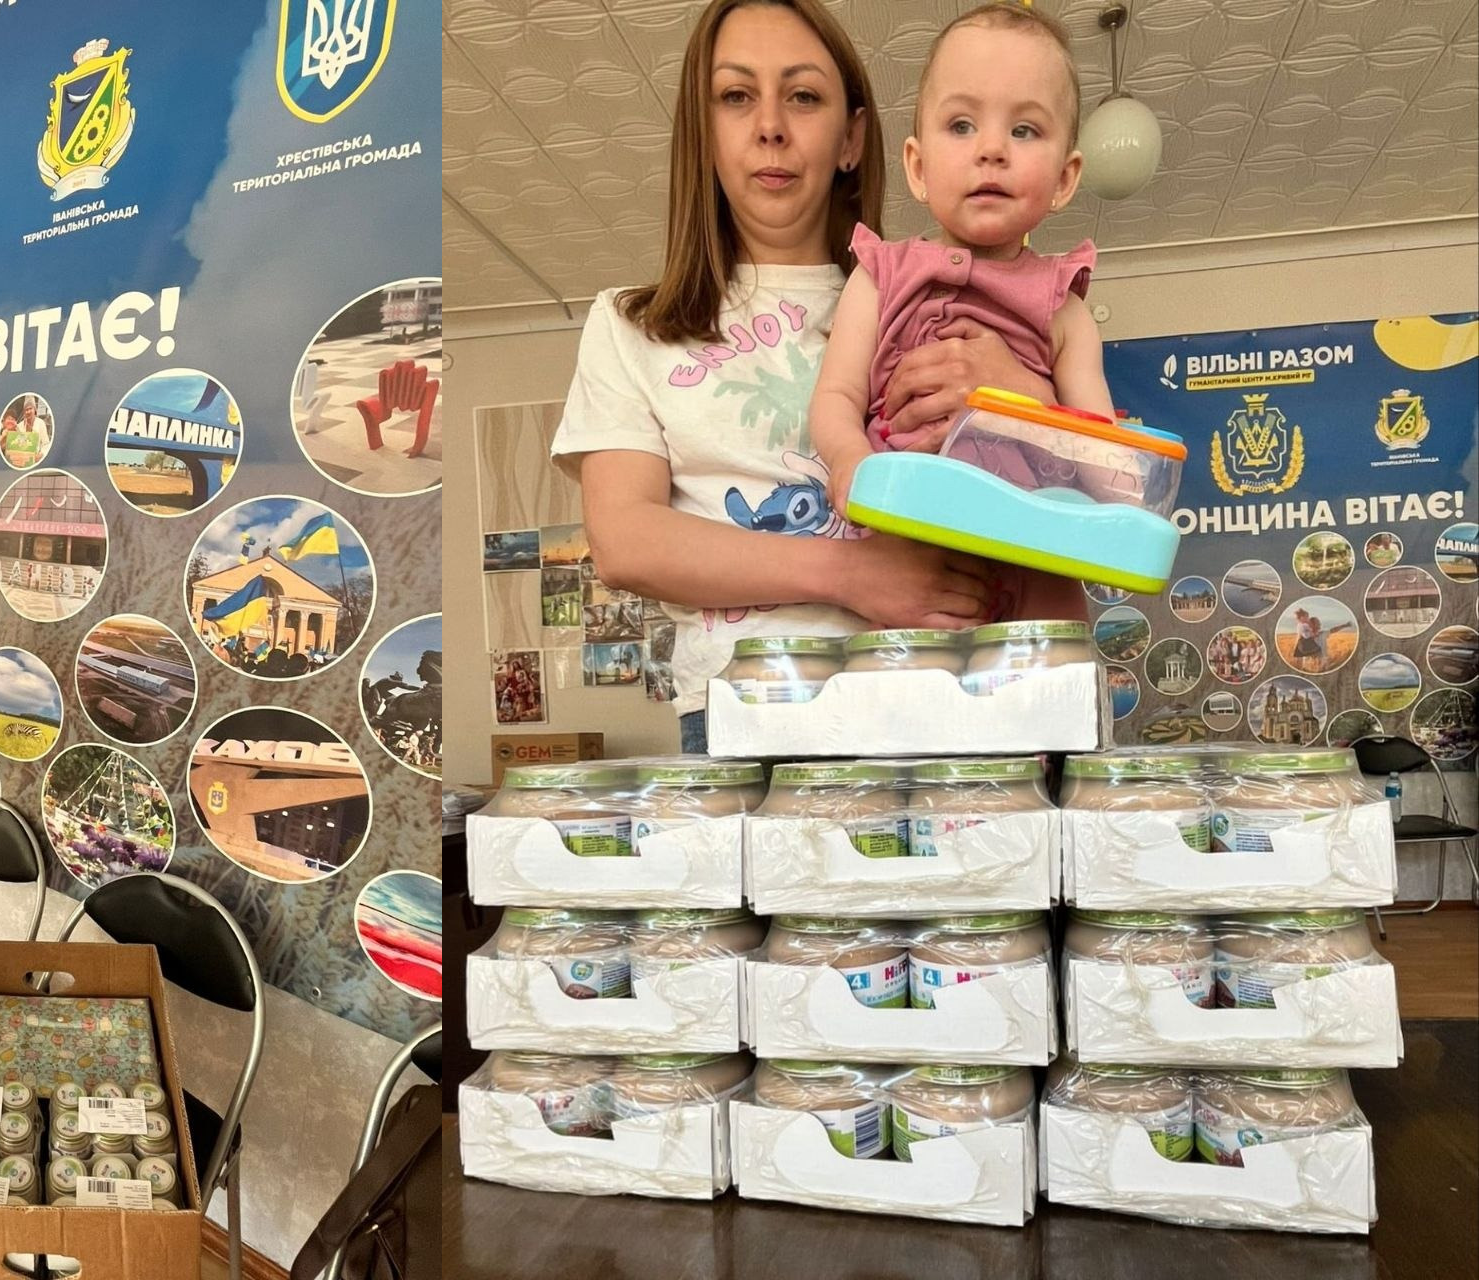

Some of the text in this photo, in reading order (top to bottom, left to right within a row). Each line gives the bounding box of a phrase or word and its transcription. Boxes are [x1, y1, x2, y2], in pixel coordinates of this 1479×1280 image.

[232, 141, 422, 193] ТЕРИТОРІАЛЬНА ГРОМАДА
[276, 133, 372, 168] ХРЕСТІВСЬКА
[22, 204, 140, 245] ТЕРИТОРІАЛЬНА ГРОМАДА
[52, 199, 105, 223] ІВАНІВСЬКА
[669, 300, 807, 388] ENJOY
[1187, 345, 1353, 375] ВІЛЬНІ РАЗОМ
[1189, 377, 1241, 387] ГУМАНІТАРНИЙ
[1242, 375, 1264, 384] ЦЕНТР
[1172, 491, 1464, 536] ОНЩИНА ВІТАЄ!
[515, 745, 551, 759] GEM
